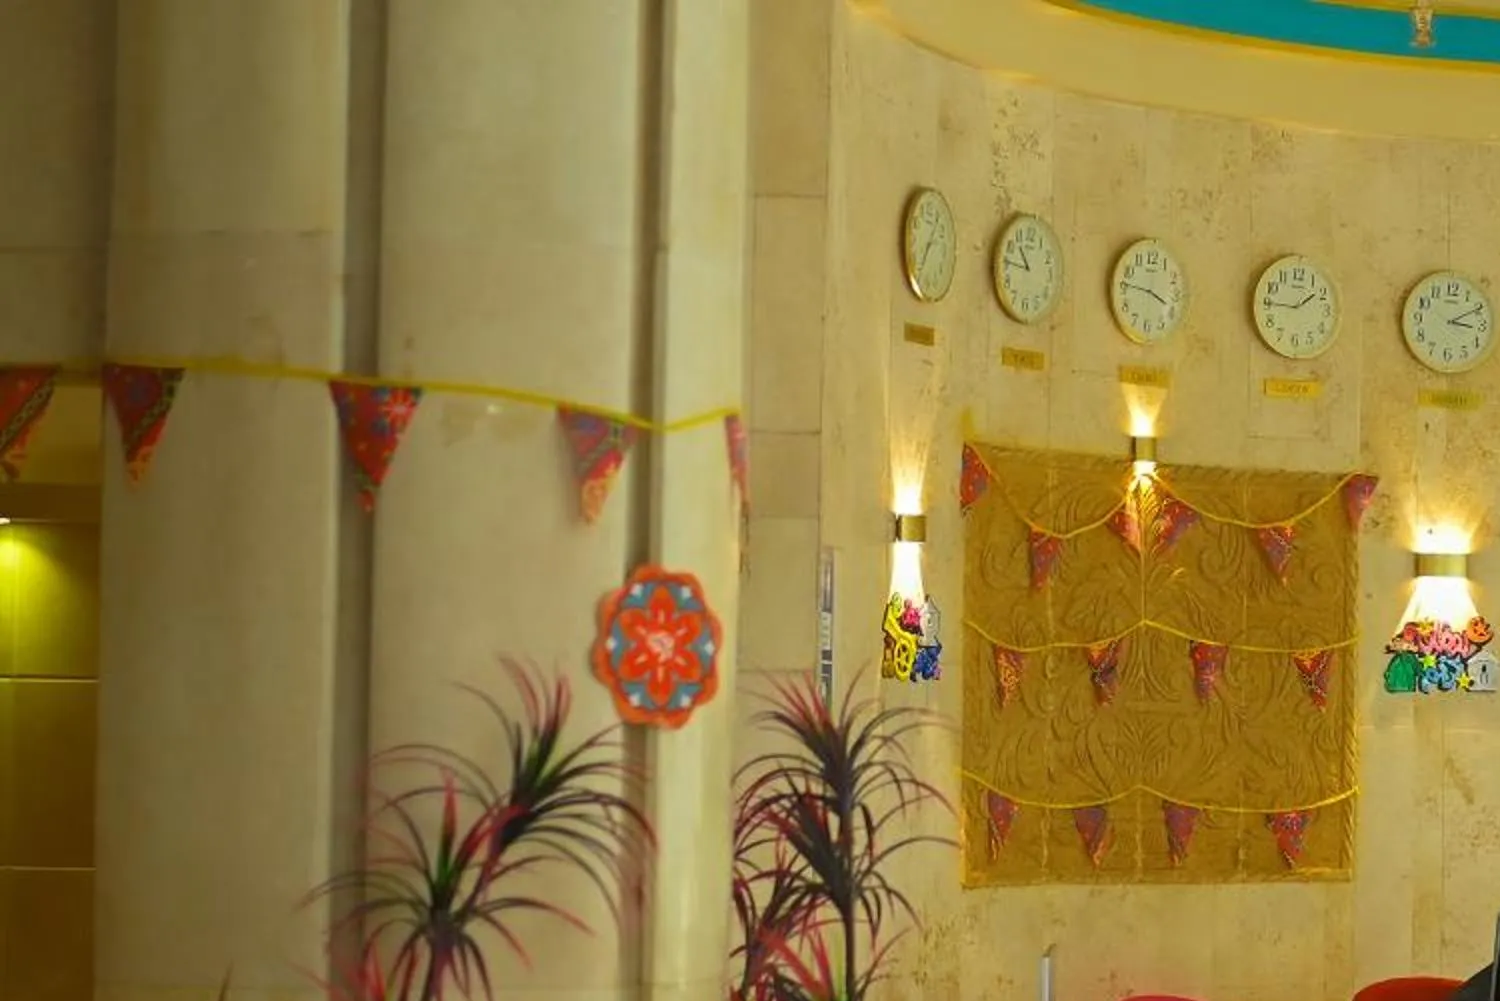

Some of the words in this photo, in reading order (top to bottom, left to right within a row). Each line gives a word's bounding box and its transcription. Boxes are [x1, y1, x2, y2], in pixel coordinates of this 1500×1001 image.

[1135, 253, 1143, 267] 11
[1147, 251, 1158, 265] 12
[1279, 269, 1287, 284] 11
[1293, 268, 1305, 281] 12
[1311, 273, 1315, 288] 1
[1267, 281, 1279, 295] 10
[1319, 287, 1327, 301] 2
[1431, 286, 1440, 299] 11
[1447, 282, 1459, 296] 12
[1419, 297, 1430, 309] 10
[1131, 312, 1138, 327] 7
[1413, 311, 1422, 325] 9
[1477, 319, 1487, 332] 3
[1417, 328, 1425, 342] 8
[1428, 342, 1436, 356] 7
[1443, 347, 1452, 360] 6
[1459, 345, 1468, 358] 5
